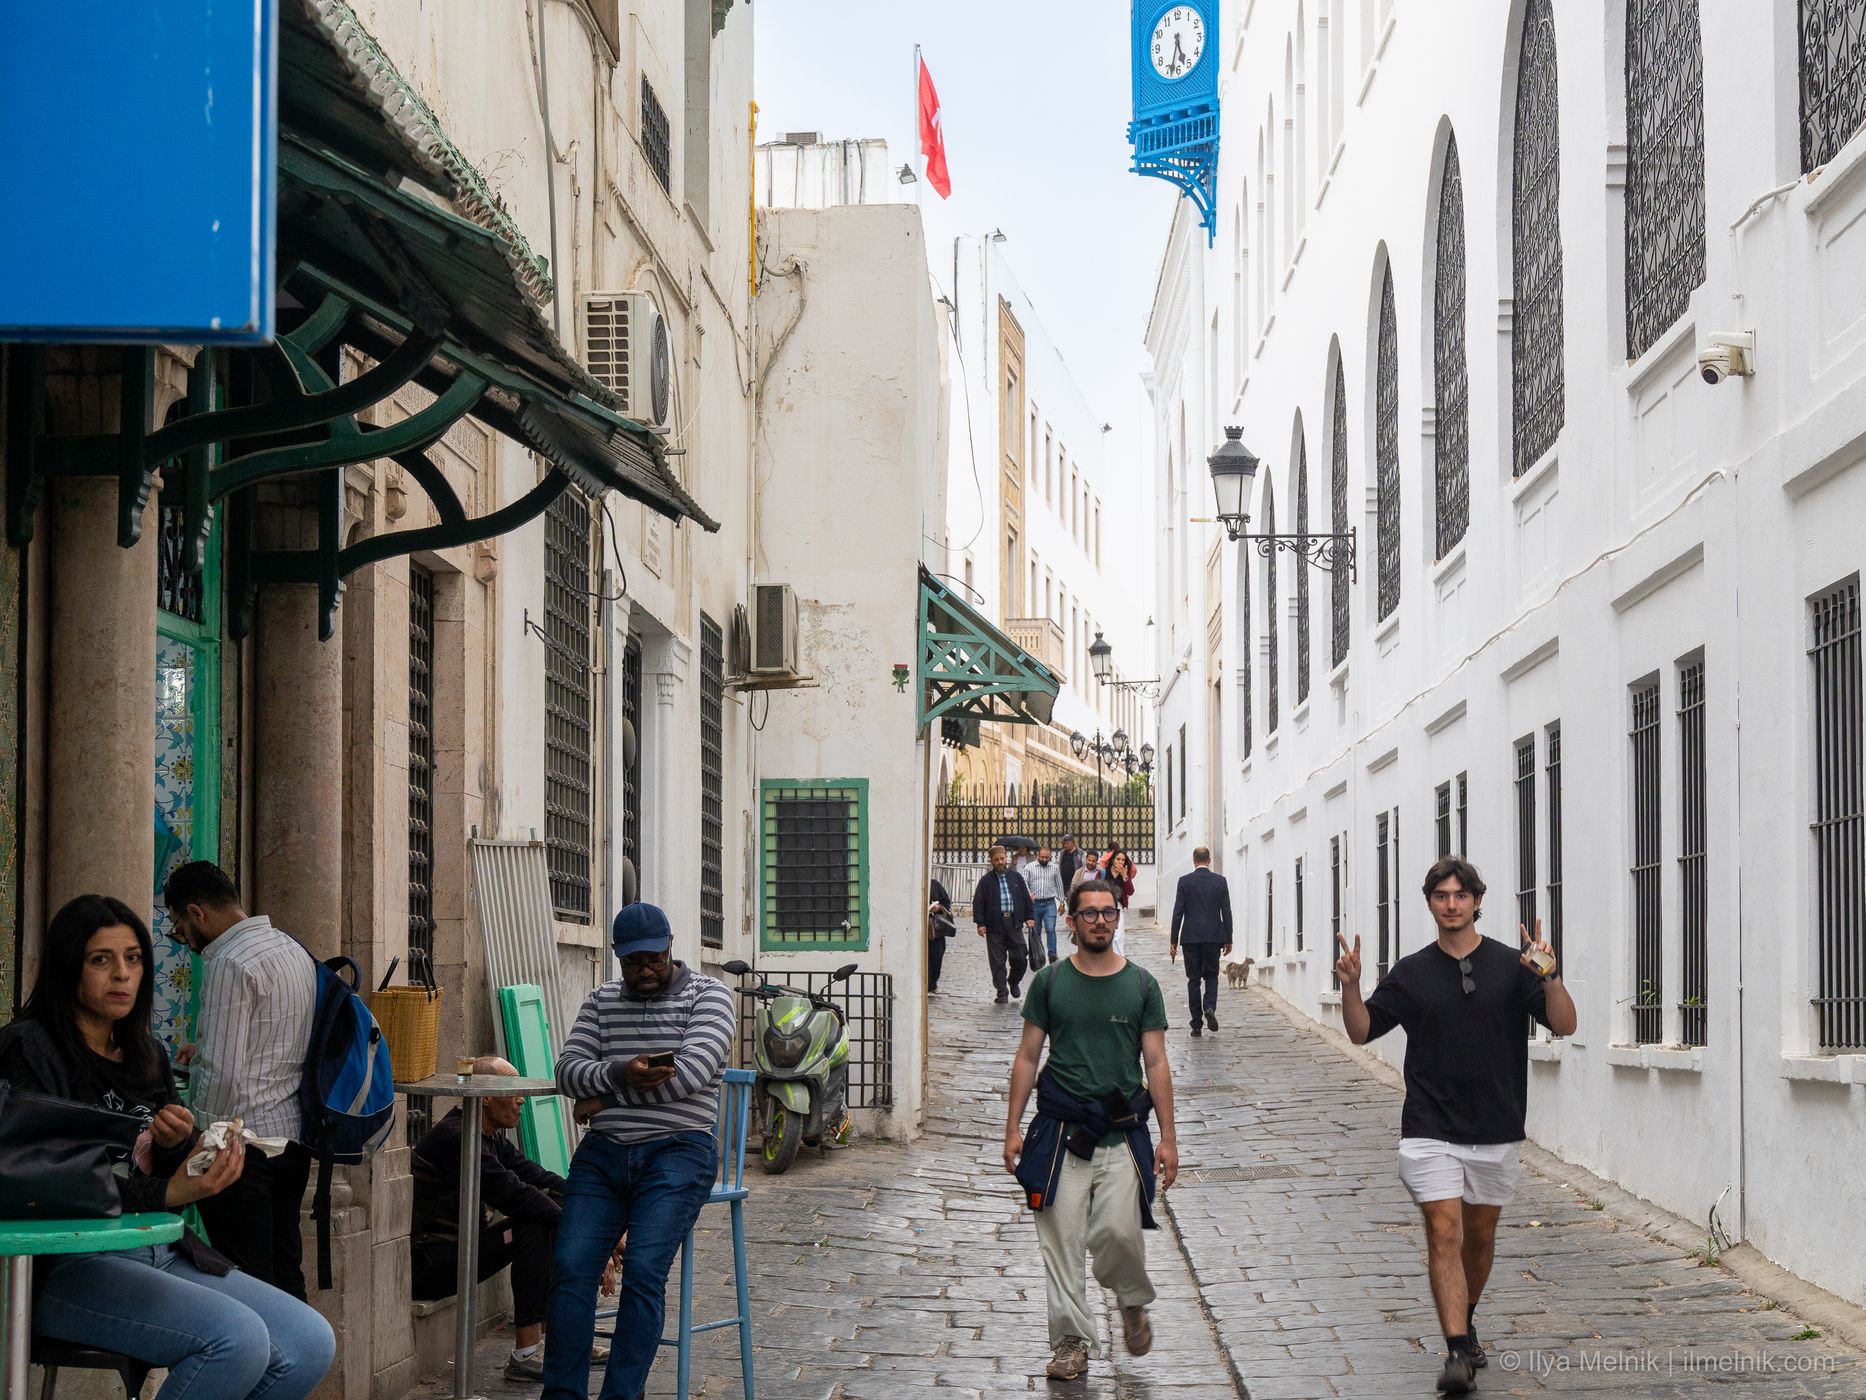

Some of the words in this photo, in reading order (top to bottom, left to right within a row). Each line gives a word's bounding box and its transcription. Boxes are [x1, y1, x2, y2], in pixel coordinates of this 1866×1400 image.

[1174, 9, 1181, 21] 12
[1164, 16, 1171, 27] 11
[1193, 19, 1200, 29] 2
[1155, 29, 1163, 39] 10
[1196, 32, 1202, 42] 3
[1155, 44, 1160, 54] 9
[1194, 47, 1199, 57] 4
[1158, 56, 1163, 66] 8
[1186, 59, 1192, 69] 5
[1176, 65, 1181, 75] 6
